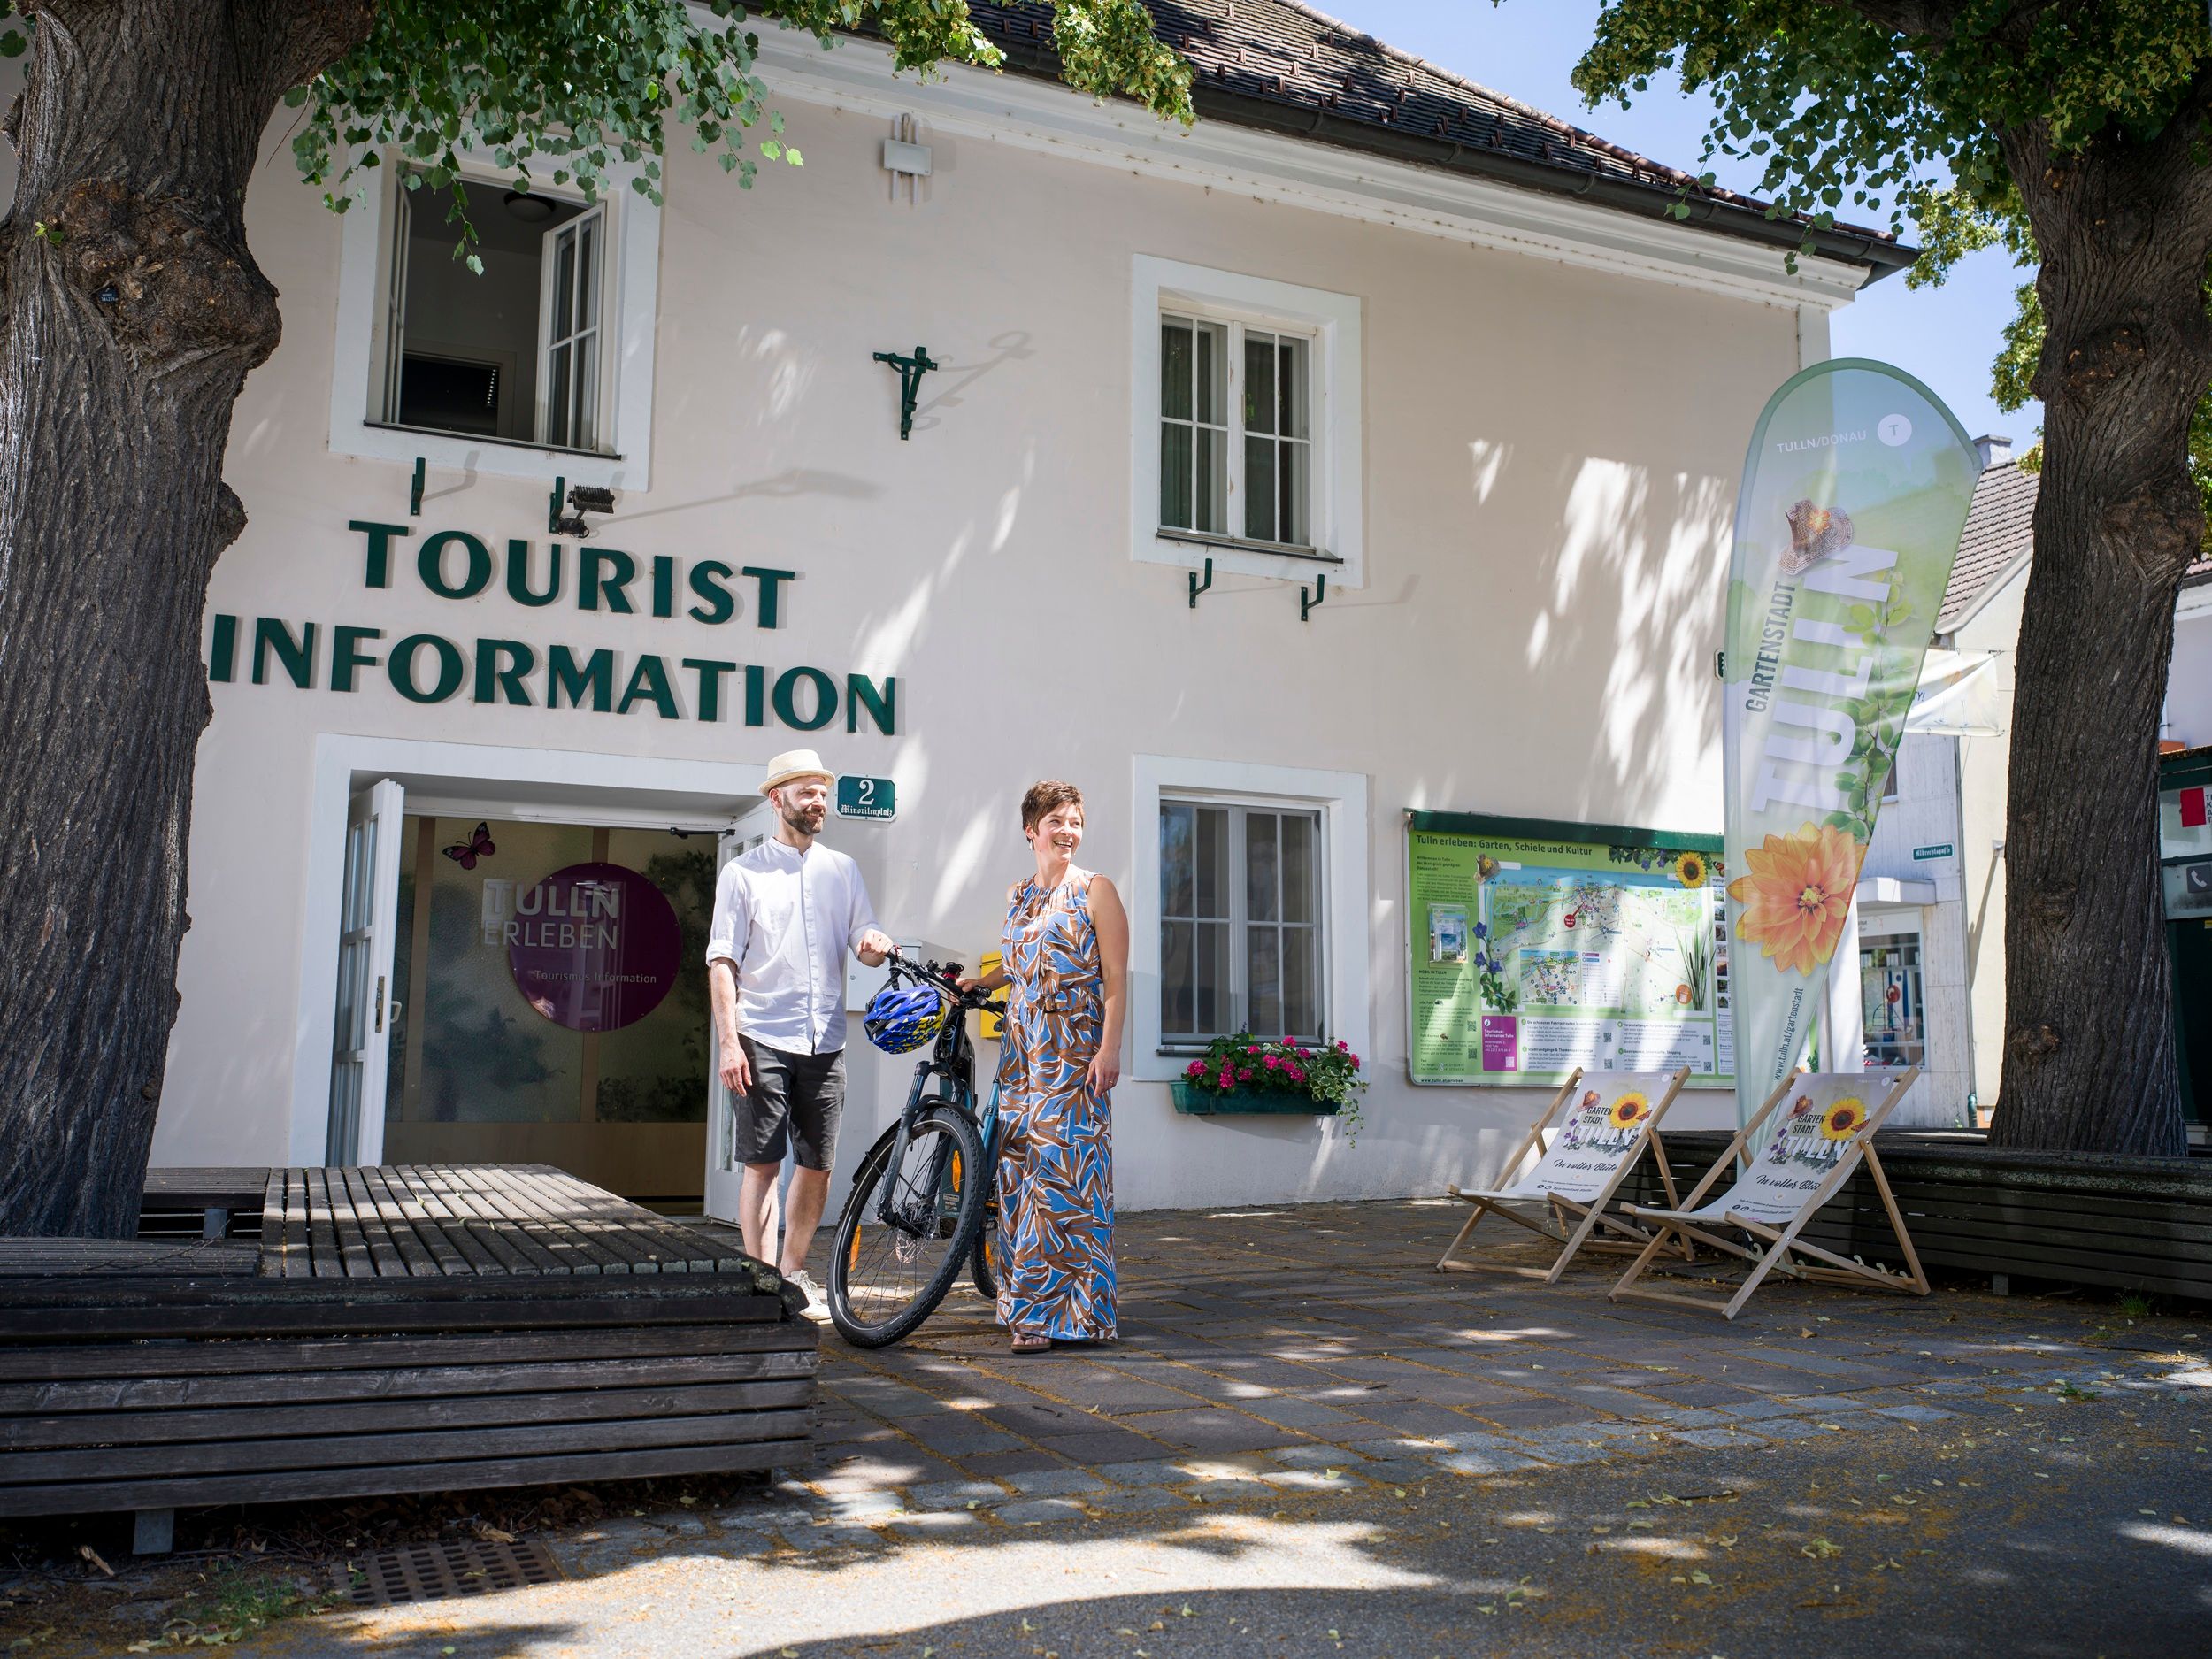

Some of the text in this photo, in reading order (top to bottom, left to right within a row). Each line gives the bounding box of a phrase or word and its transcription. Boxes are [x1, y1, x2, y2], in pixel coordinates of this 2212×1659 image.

[1777, 431, 1867, 453] TULLN/DONAU
[349, 520, 795, 629] TOURIST
[1745, 581, 1796, 713] GARTENSTADT
[210, 613, 895, 735] INFORMATION
[858, 779, 874, 805] 2
[1417, 835, 1593, 856] Tulln erleben: Garten, Schiele und Kultur
[487, 884, 618, 918] TULLN
[484, 920, 618, 950] ERLEBEN
[534, 970, 657, 984] Tourismus Information
[1774, 987, 1804, 1081] www.tulln.at/gartenstadt
[1583, 1116, 1605, 1125] STADT
[1587, 1106, 1613, 1115] GARTEN
[1797, 1113, 1826, 1125] GARTEN
[1792, 1125, 1816, 1134] STADT
[1554, 1159, 1618, 1171] In voller Blüte
[1755, 1174, 1822, 1191] In voller Blüt
